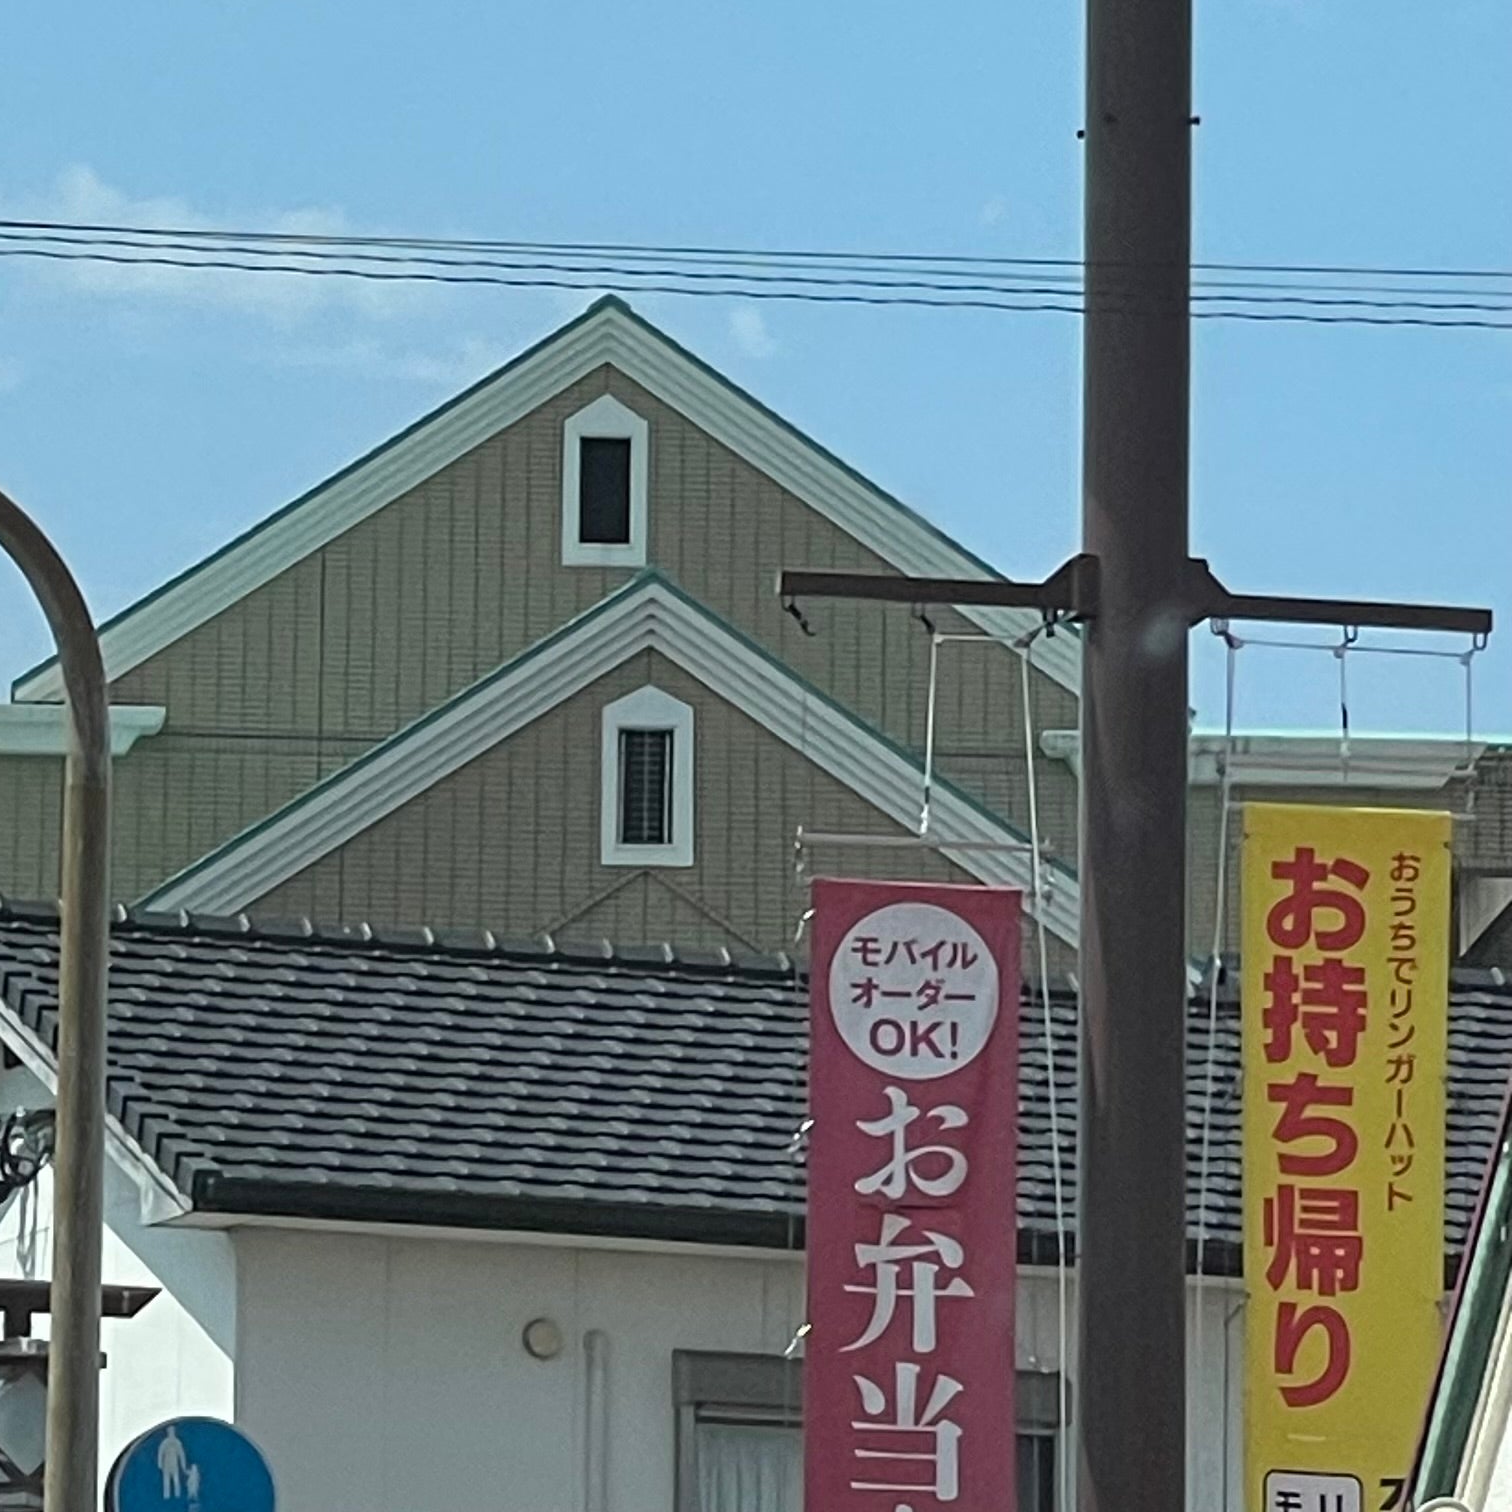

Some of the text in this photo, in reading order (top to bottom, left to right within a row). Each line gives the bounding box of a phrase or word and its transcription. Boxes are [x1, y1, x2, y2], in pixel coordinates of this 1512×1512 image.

[849, 976, 977, 1011] オーダー
[850, 936, 979, 972] モバイル
[868, 1017, 959, 1061] OK!
[1384, 851, 1422, 1212] おうちでリンガーハット
[1261, 844, 1371, 1410] お持ち帰り
[837, 1085, 976, 1512] お弁当
